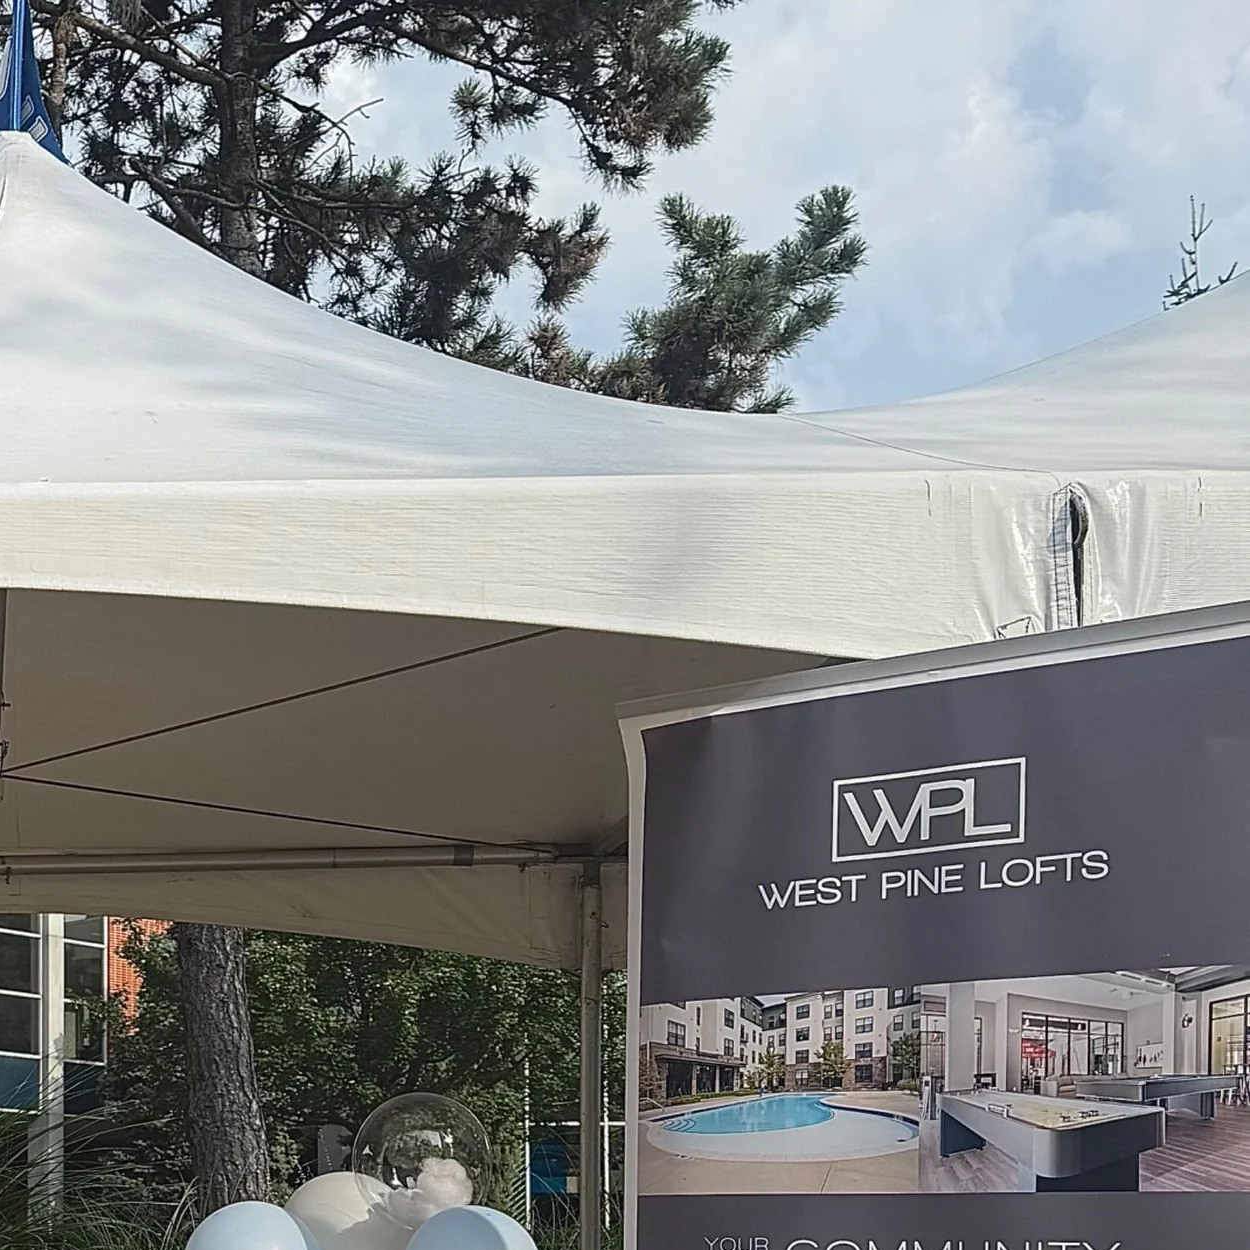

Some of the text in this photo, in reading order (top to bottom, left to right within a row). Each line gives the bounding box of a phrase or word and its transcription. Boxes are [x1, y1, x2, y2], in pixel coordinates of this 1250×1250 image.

[843, 778, 1011, 847] WPL
[758, 850, 1110, 910] WEST PINE LOFTS
